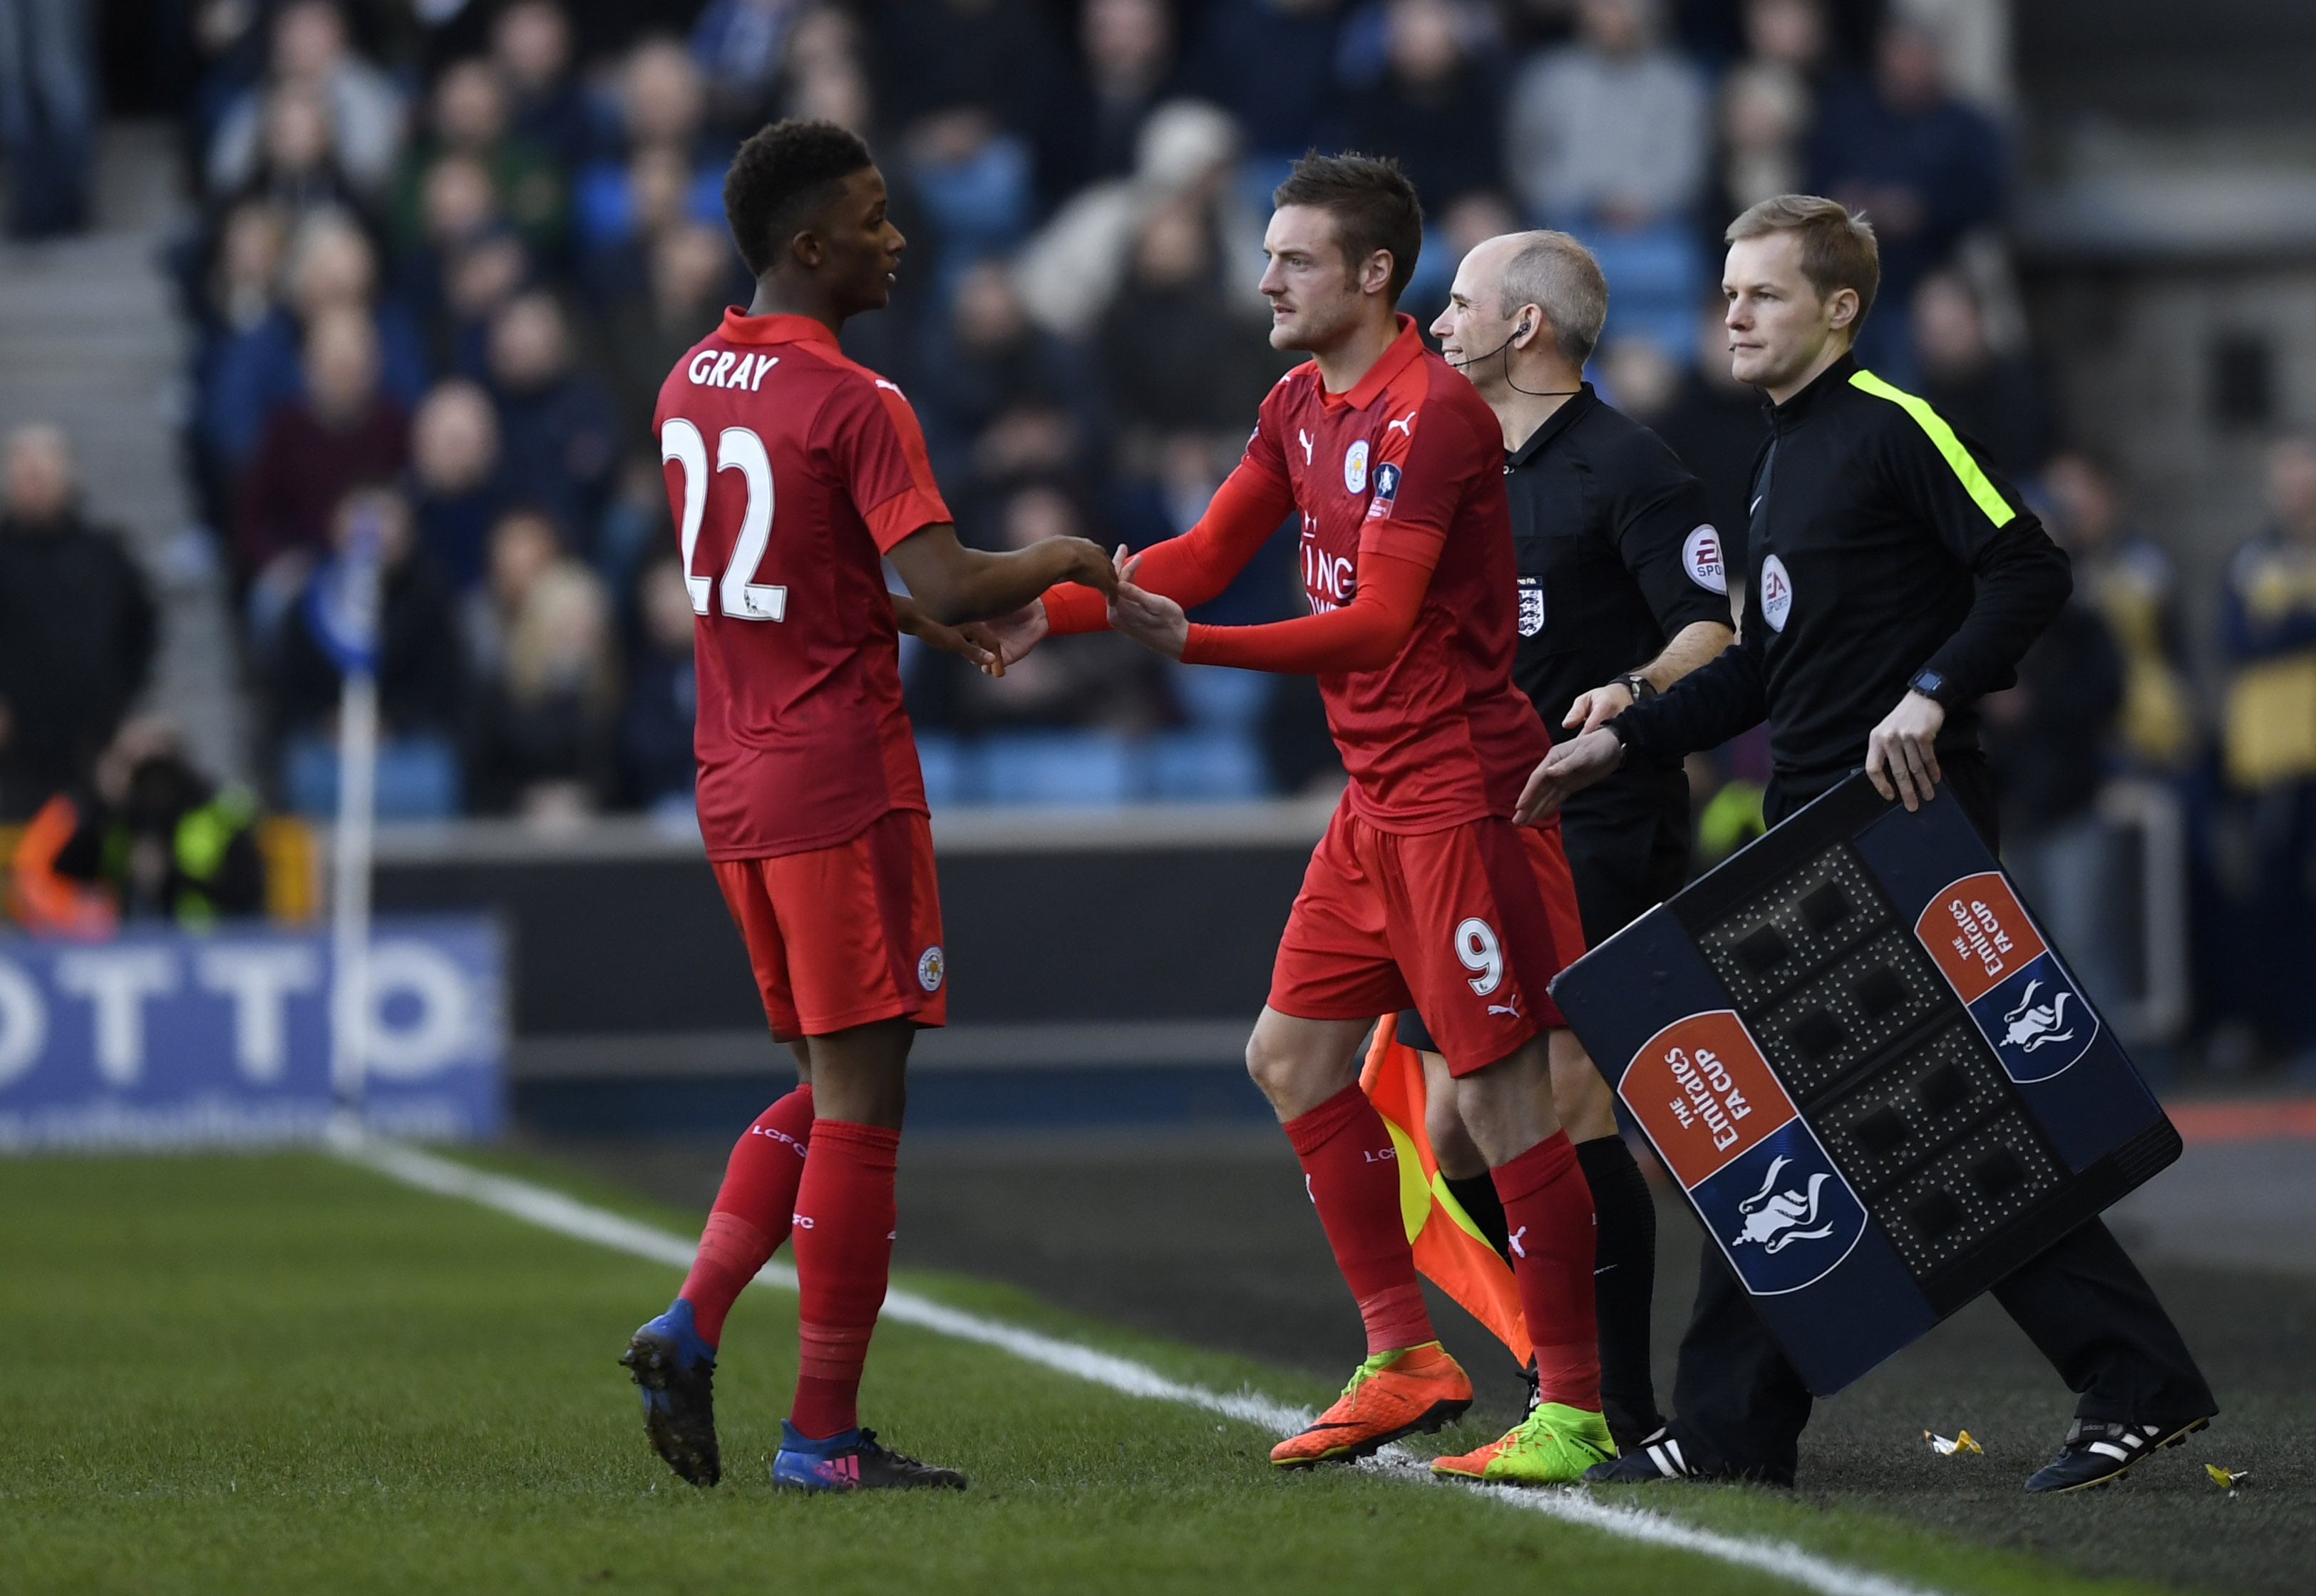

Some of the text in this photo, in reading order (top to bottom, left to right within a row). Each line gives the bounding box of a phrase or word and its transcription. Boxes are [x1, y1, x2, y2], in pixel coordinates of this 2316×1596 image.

[688, 349, 779, 391] GRAY
[662, 418, 788, 623] 22
[1299, 541, 1357, 599] ING
[1697, 565, 1724, 577] SPO
[1948, 900, 2004, 977] Emirates
[1952, 936, 1971, 961] THE
[1971, 900, 2013, 954] FA CUP
[1455, 917, 1503, 996] 9
[1664, 1047, 1739, 1152] Emirates
[1669, 1096, 1694, 1129] THE
[1694, 1049, 1751, 1121] FA CUP
[752, 1125, 807, 1158] LCFC
